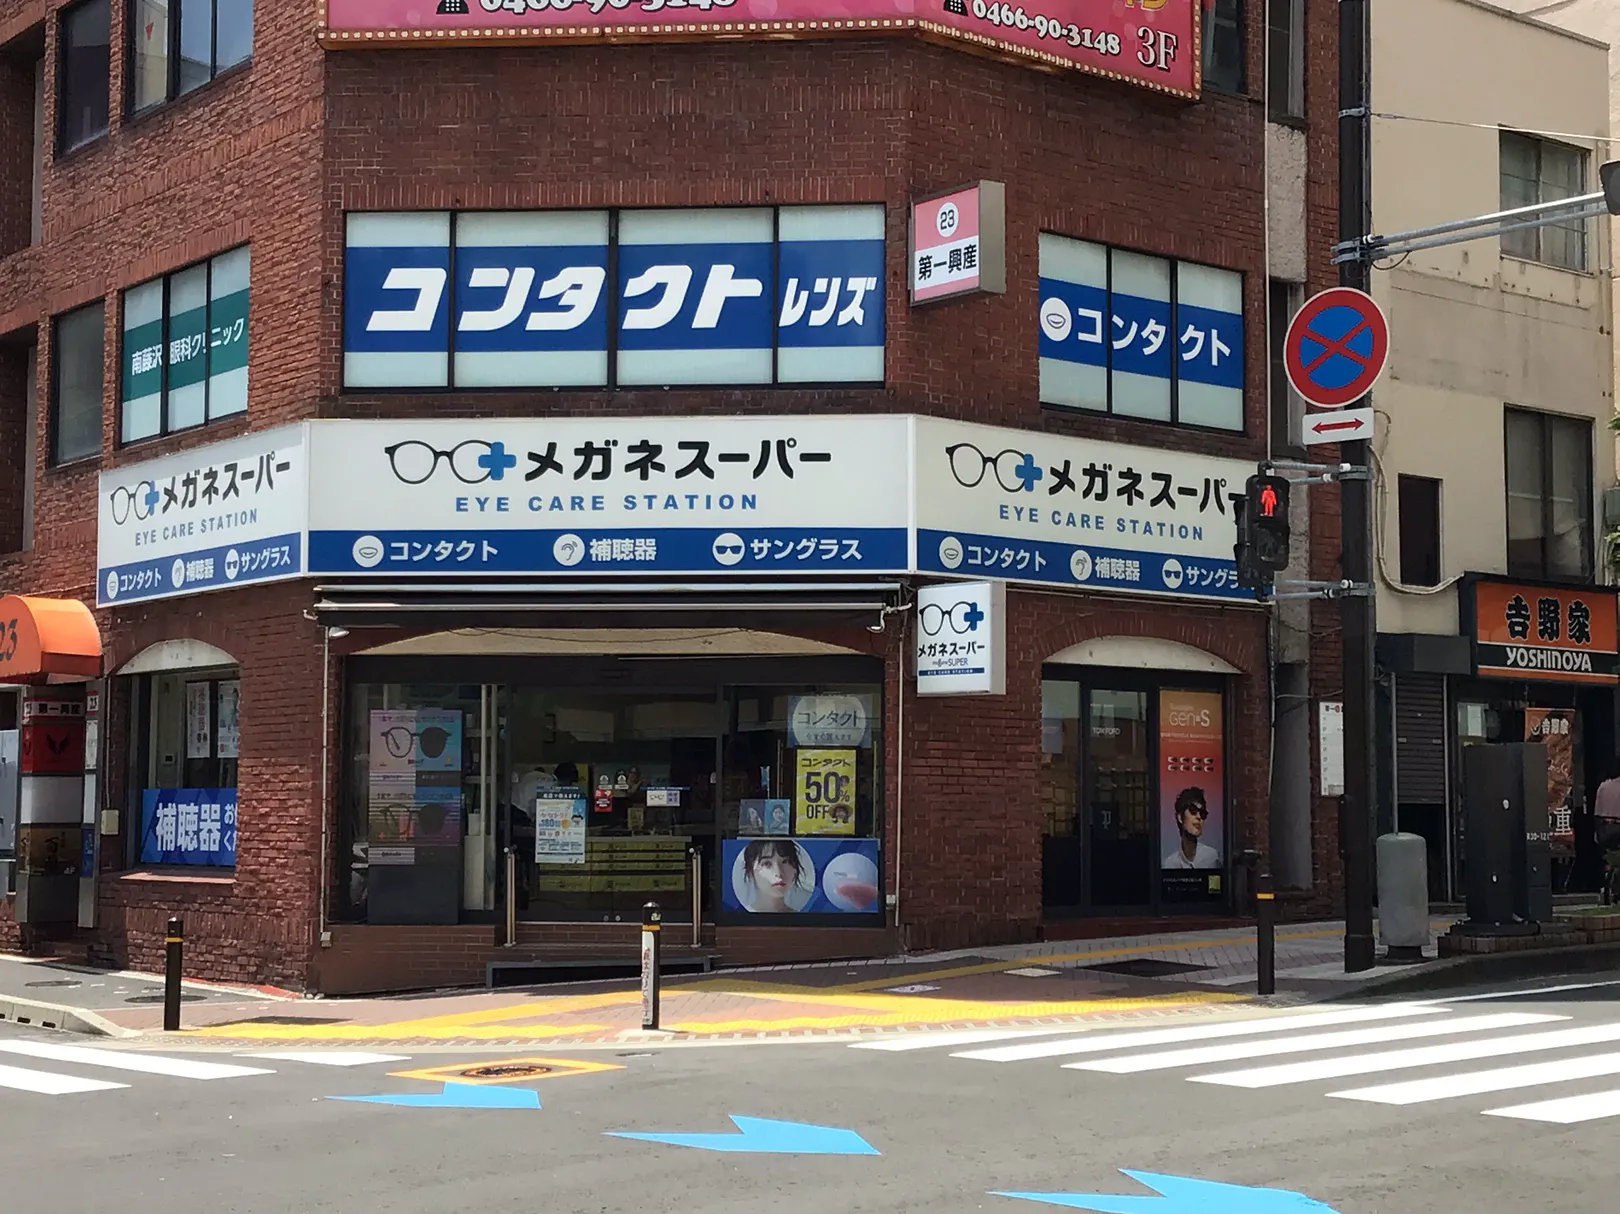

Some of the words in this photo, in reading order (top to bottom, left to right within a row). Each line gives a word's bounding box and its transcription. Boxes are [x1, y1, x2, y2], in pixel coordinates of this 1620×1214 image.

[971, 0, 1121, 55] 0466-90-3148
[1136, 25, 1178, 71] 3F
[940, 209, 955, 230] 23
[917, 243, 977, 282] 第一興産
[1077, 307, 1232, 366] コンタクト
[524, 438, 832, 482] メガネスーパー
[162, 451, 290, 514] メガネスーパー
[1048, 459, 1248, 516] メガネスーパー
[455, 495, 510, 513] EYE
[528, 495, 606, 513] CARE
[623, 494, 758, 512] STATION
[1000, 504, 1039, 523] EYE
[1051, 510, 1105, 531] CARE
[1116, 517, 1203, 541] STATION
[135, 529, 157, 547] EYE
[162, 521, 195, 541] CARE
[200, 508, 258, 533] STATION
[120, 567, 162, 592] コンタクト
[240, 545, 291, 573] サングラス
[390, 540, 499, 562] コンタクト
[589, 538, 657, 562] 補聴器
[750, 538, 863, 562] サングラス
[966, 545, 1047, 572] コンタクト
[1094, 557, 1141, 582] 補聴器
[1186, 565, 1256, 590] サングラ
[1505, 646, 1592, 672] YOSHINOYA
[797, 709, 858, 728] コンタクト
[801, 758, 851, 768] コンタクト
[155, 802, 221, 852] 補聴器
[224, 803, 238, 825] お
[806, 804, 829, 819] OFF
[223, 829, 237, 852] く
